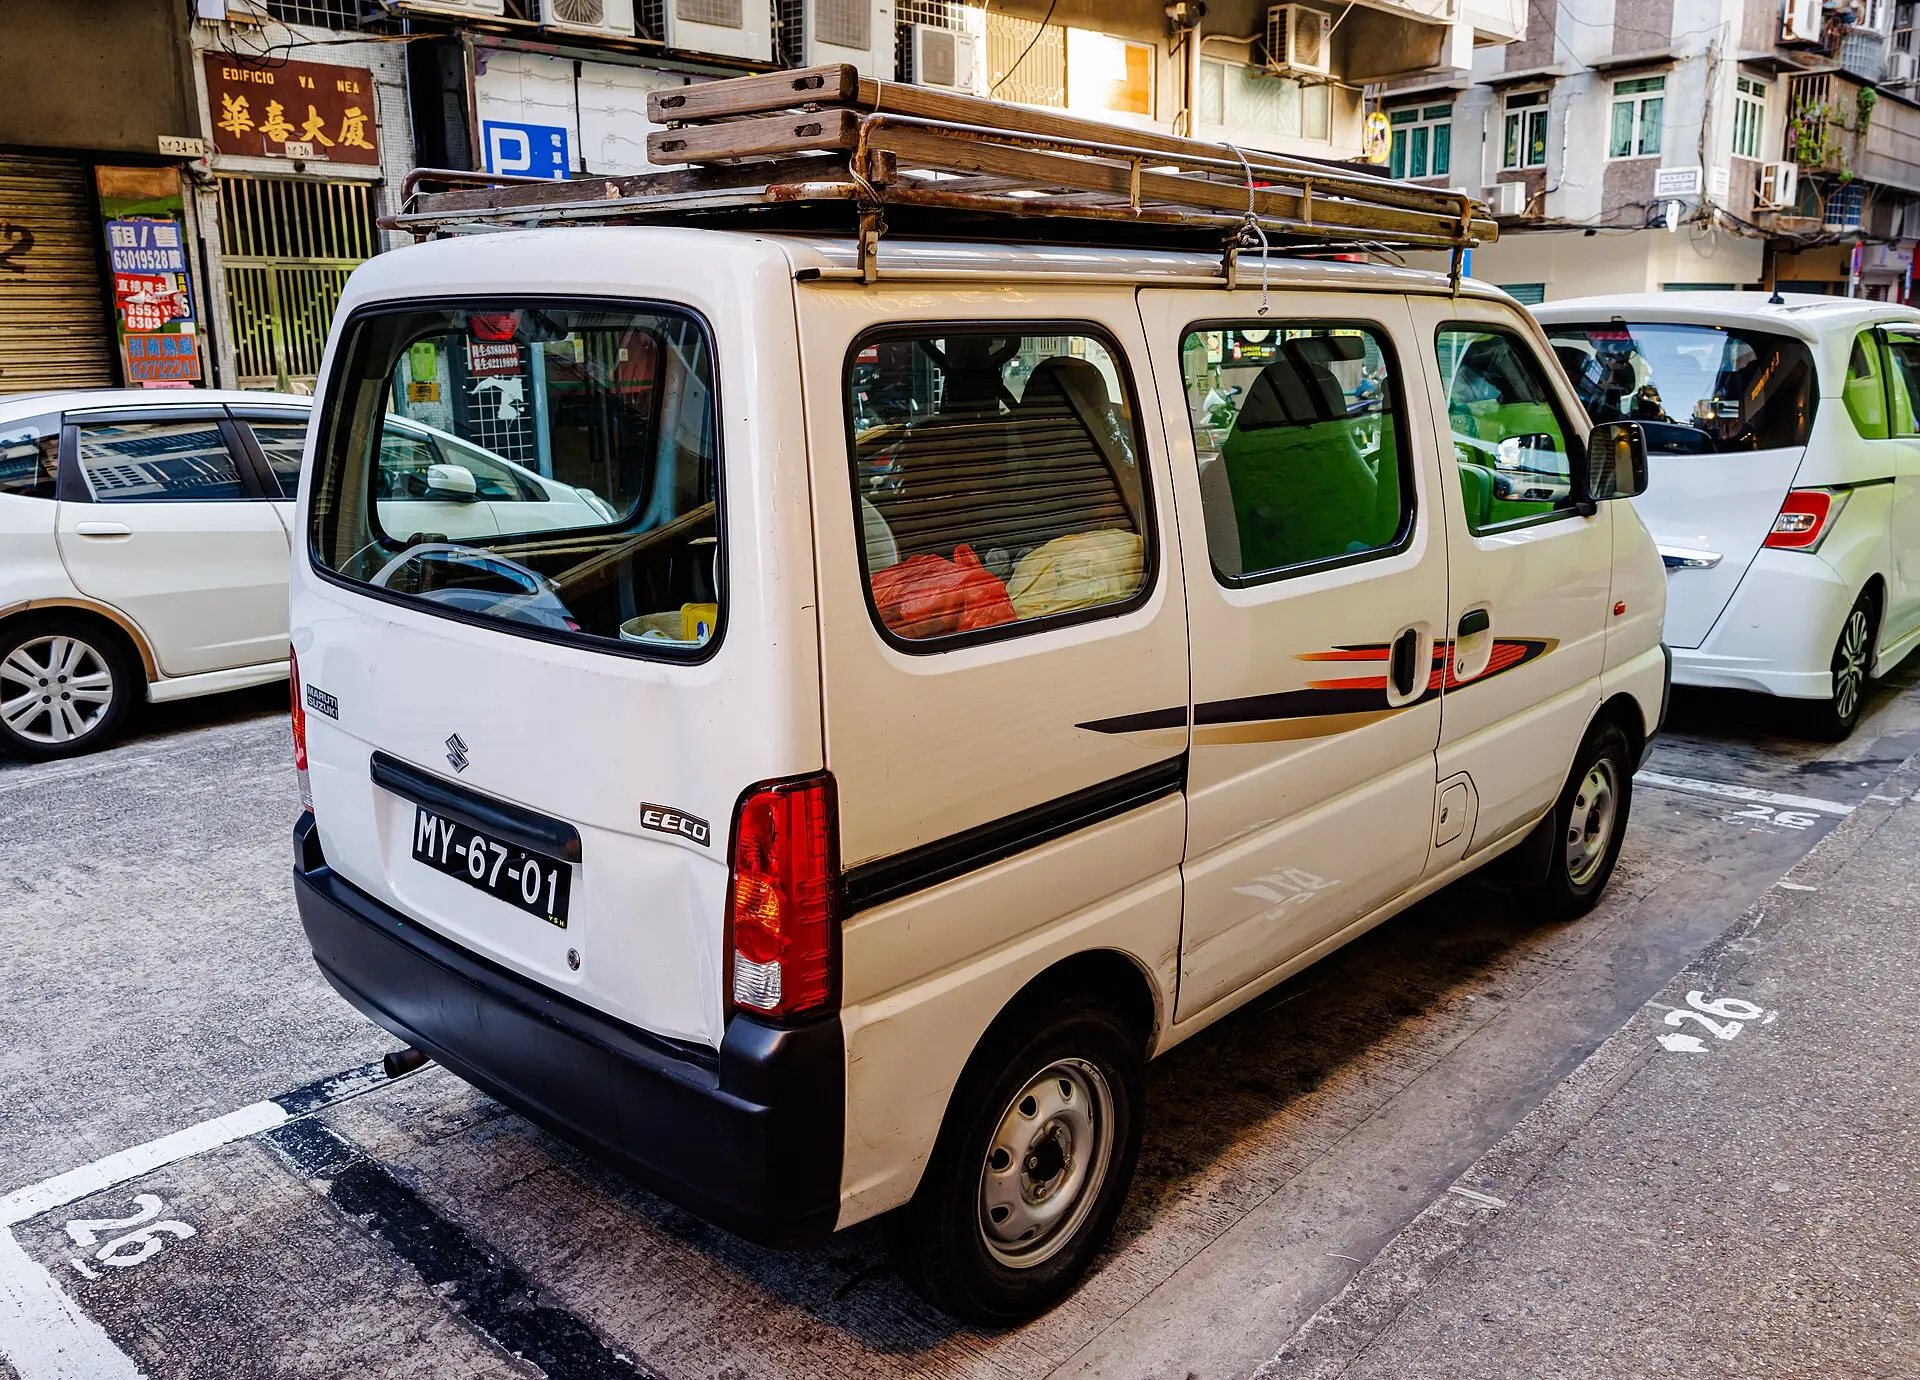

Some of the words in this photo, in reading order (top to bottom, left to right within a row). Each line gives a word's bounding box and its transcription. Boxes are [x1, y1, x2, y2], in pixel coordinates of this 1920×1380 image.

[222, 67, 275, 85] EDIFICIO
[299, 75, 316, 90] VA
[336, 79, 360, 94] NEA
[299, 145, 310, 156] 26
[489, 127, 531, 176] P
[131, 360, 199, 379] 62722241
[307, 685, 338, 708] MARUTI
[307, 696, 338, 719] SUZUKI
[642, 810, 708, 841] EECO
[416, 810, 558, 915] MY-67-01
[1664, 990, 1764, 1041] 26
[65, 1193, 197, 1267] 26
